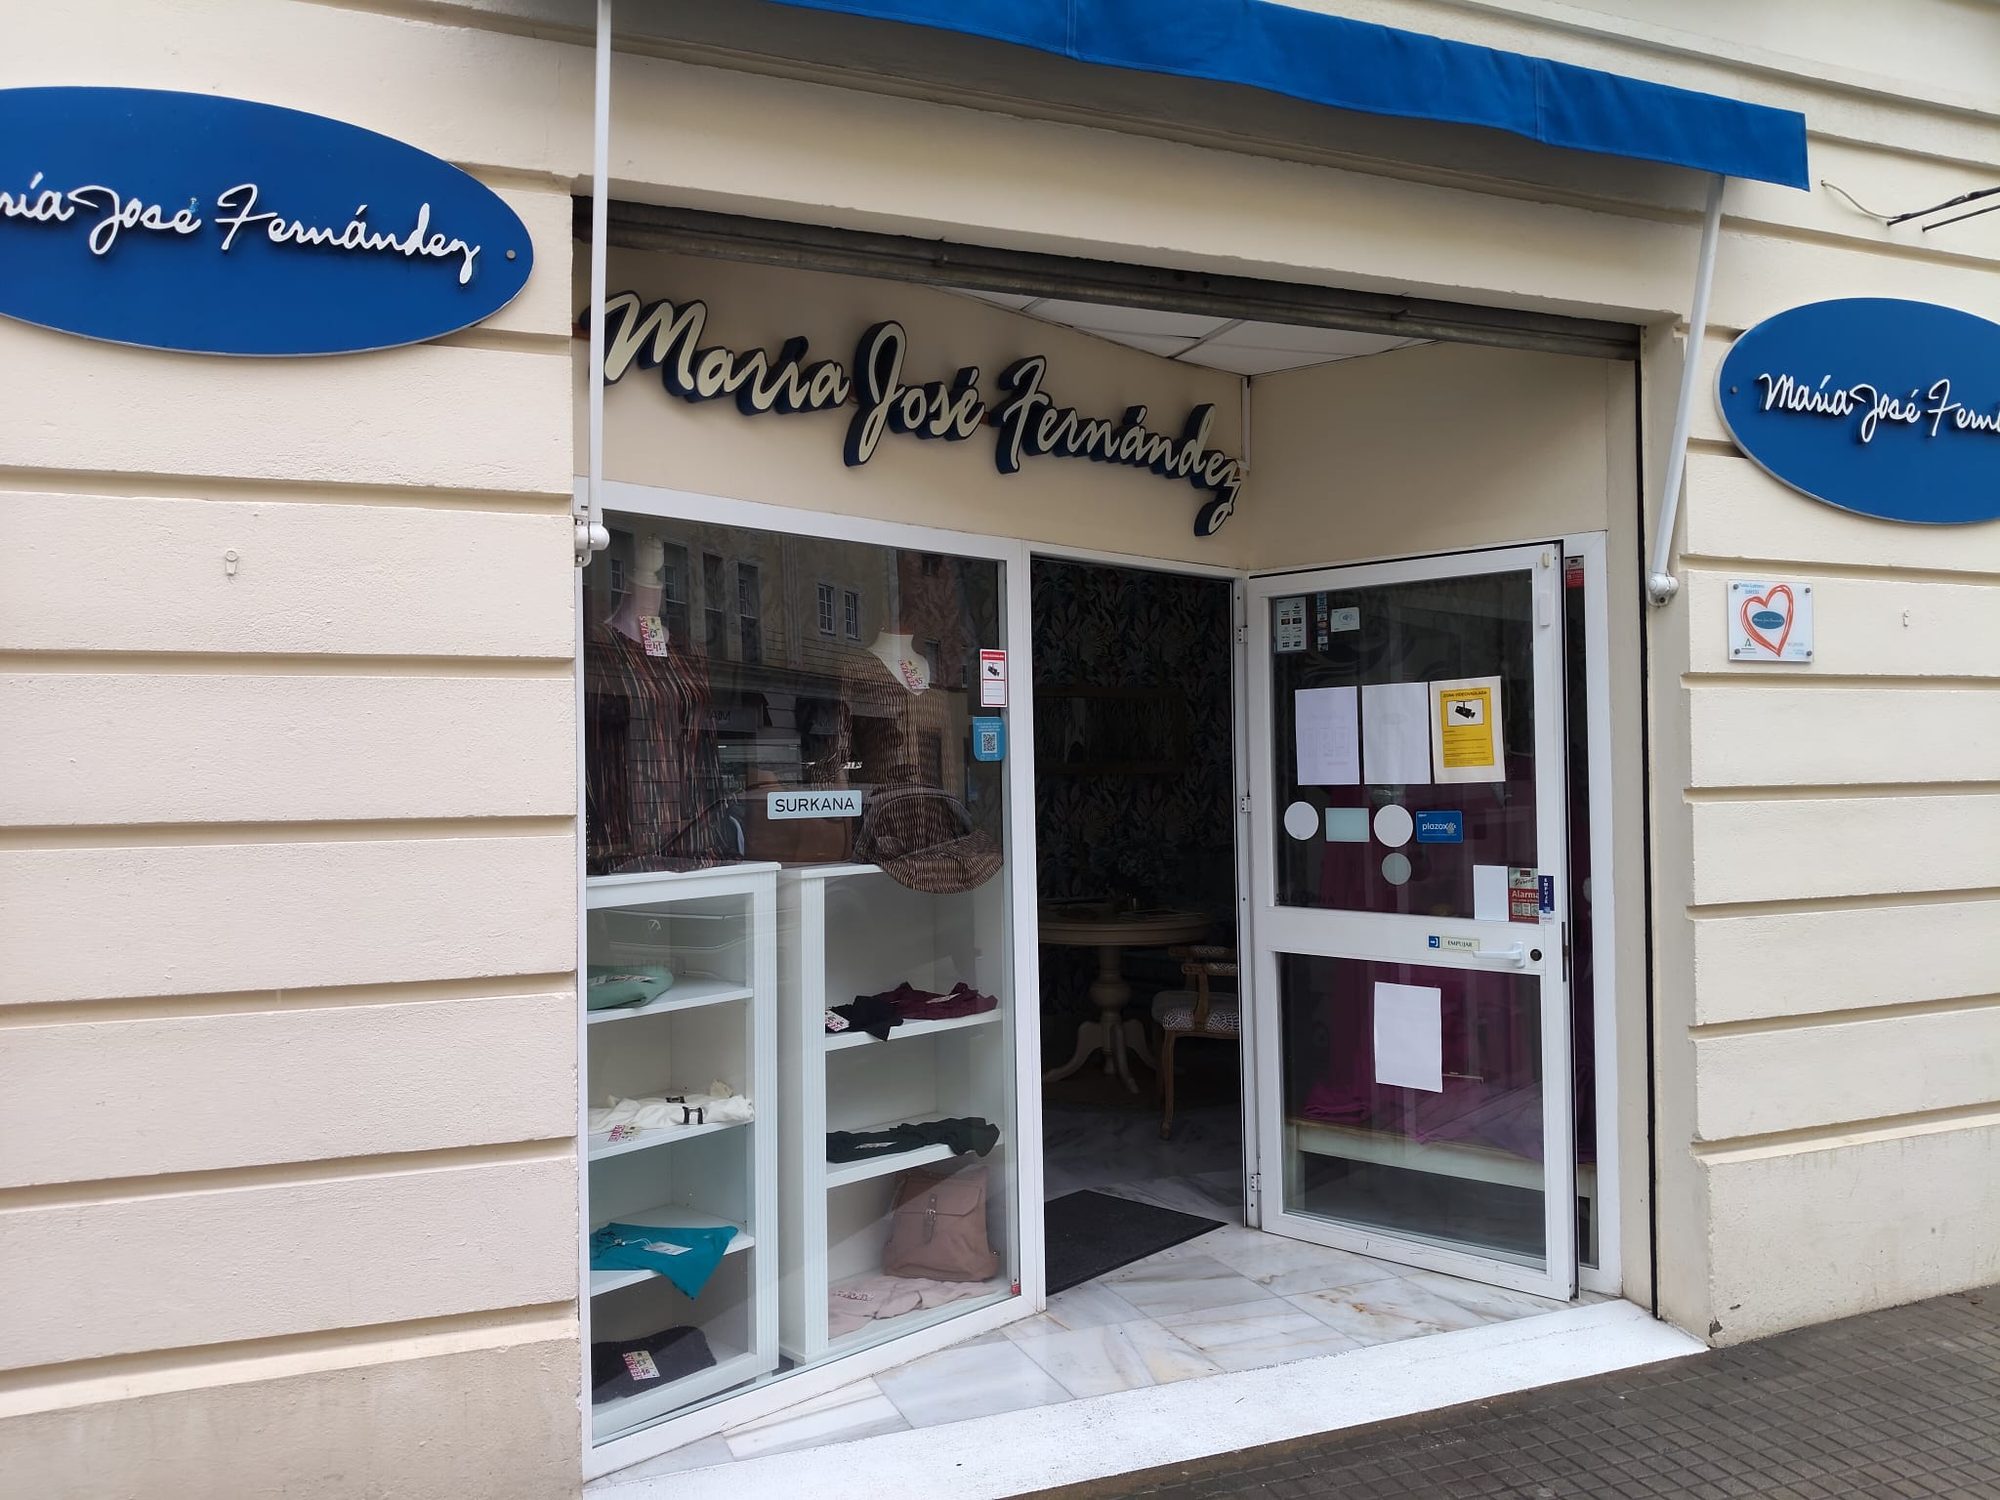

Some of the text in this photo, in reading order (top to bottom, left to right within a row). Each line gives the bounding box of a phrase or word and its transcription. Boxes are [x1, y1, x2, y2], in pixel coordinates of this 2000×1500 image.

[215, 183, 481, 285] Fernández
[580, 289, 1241, 538] María José Fernández
[1758, 372, 2000, 444] María José Fern
[775, 797, 855, 812] SURKANA
